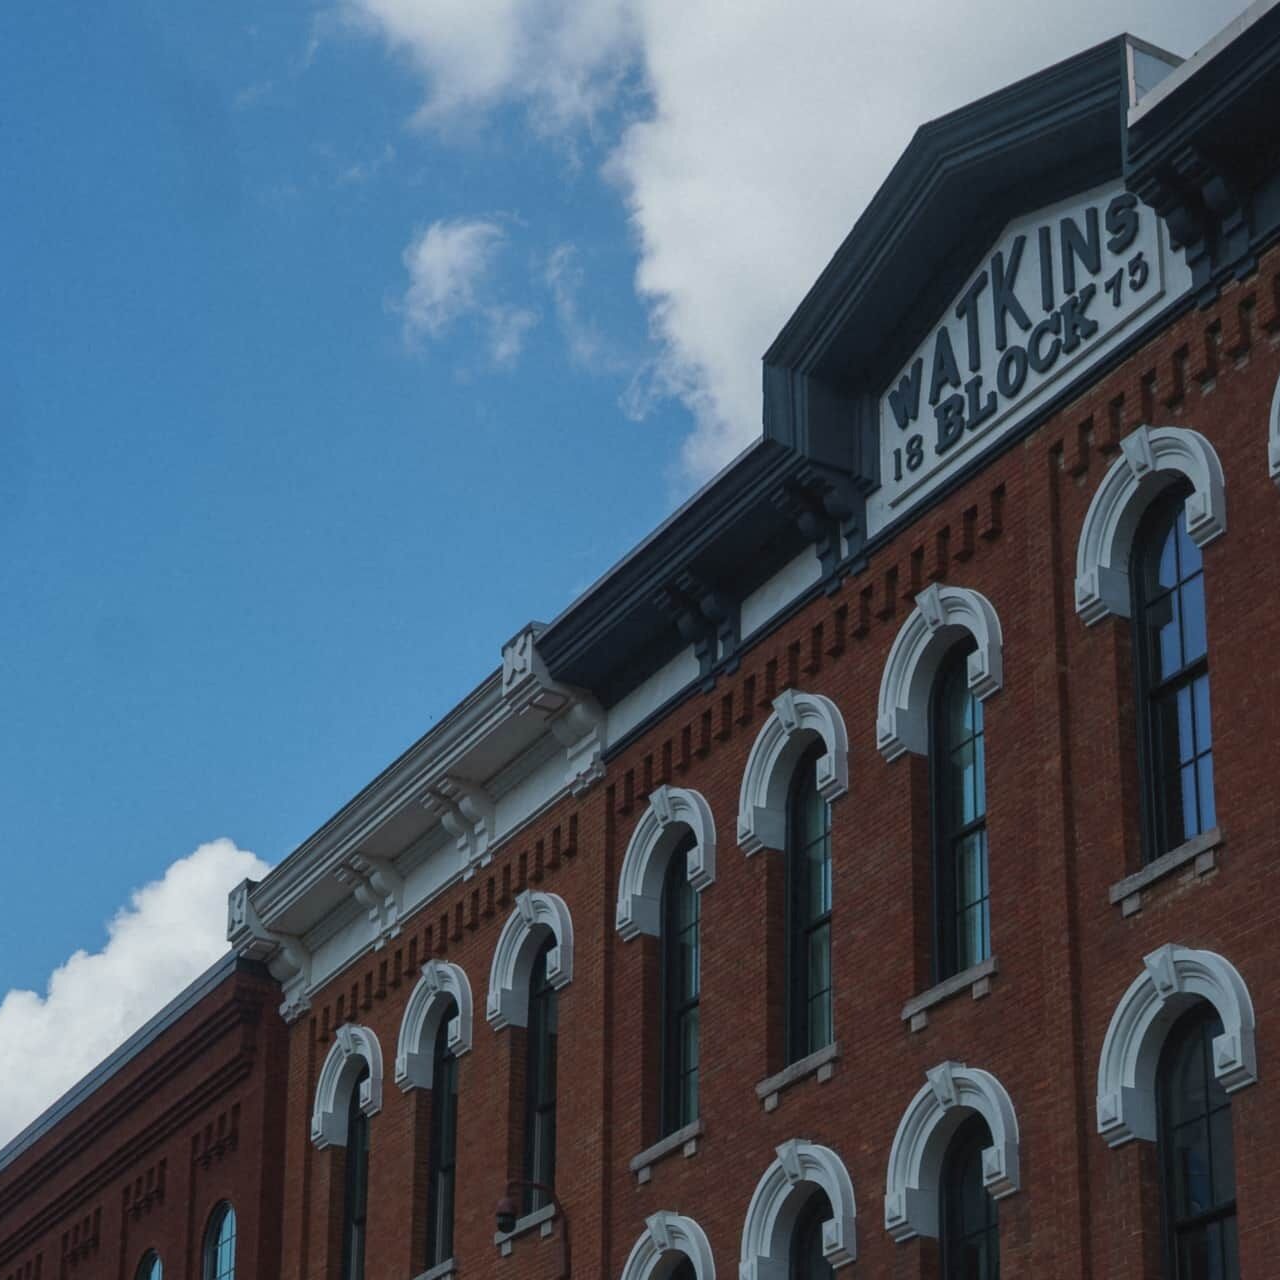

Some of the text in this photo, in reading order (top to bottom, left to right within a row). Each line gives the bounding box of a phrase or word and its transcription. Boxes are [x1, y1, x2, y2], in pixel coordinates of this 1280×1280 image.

[888, 192, 1139, 430] WATKINS
[893, 434, 924, 481] 18
[934, 283, 1098, 455] BLOCK
